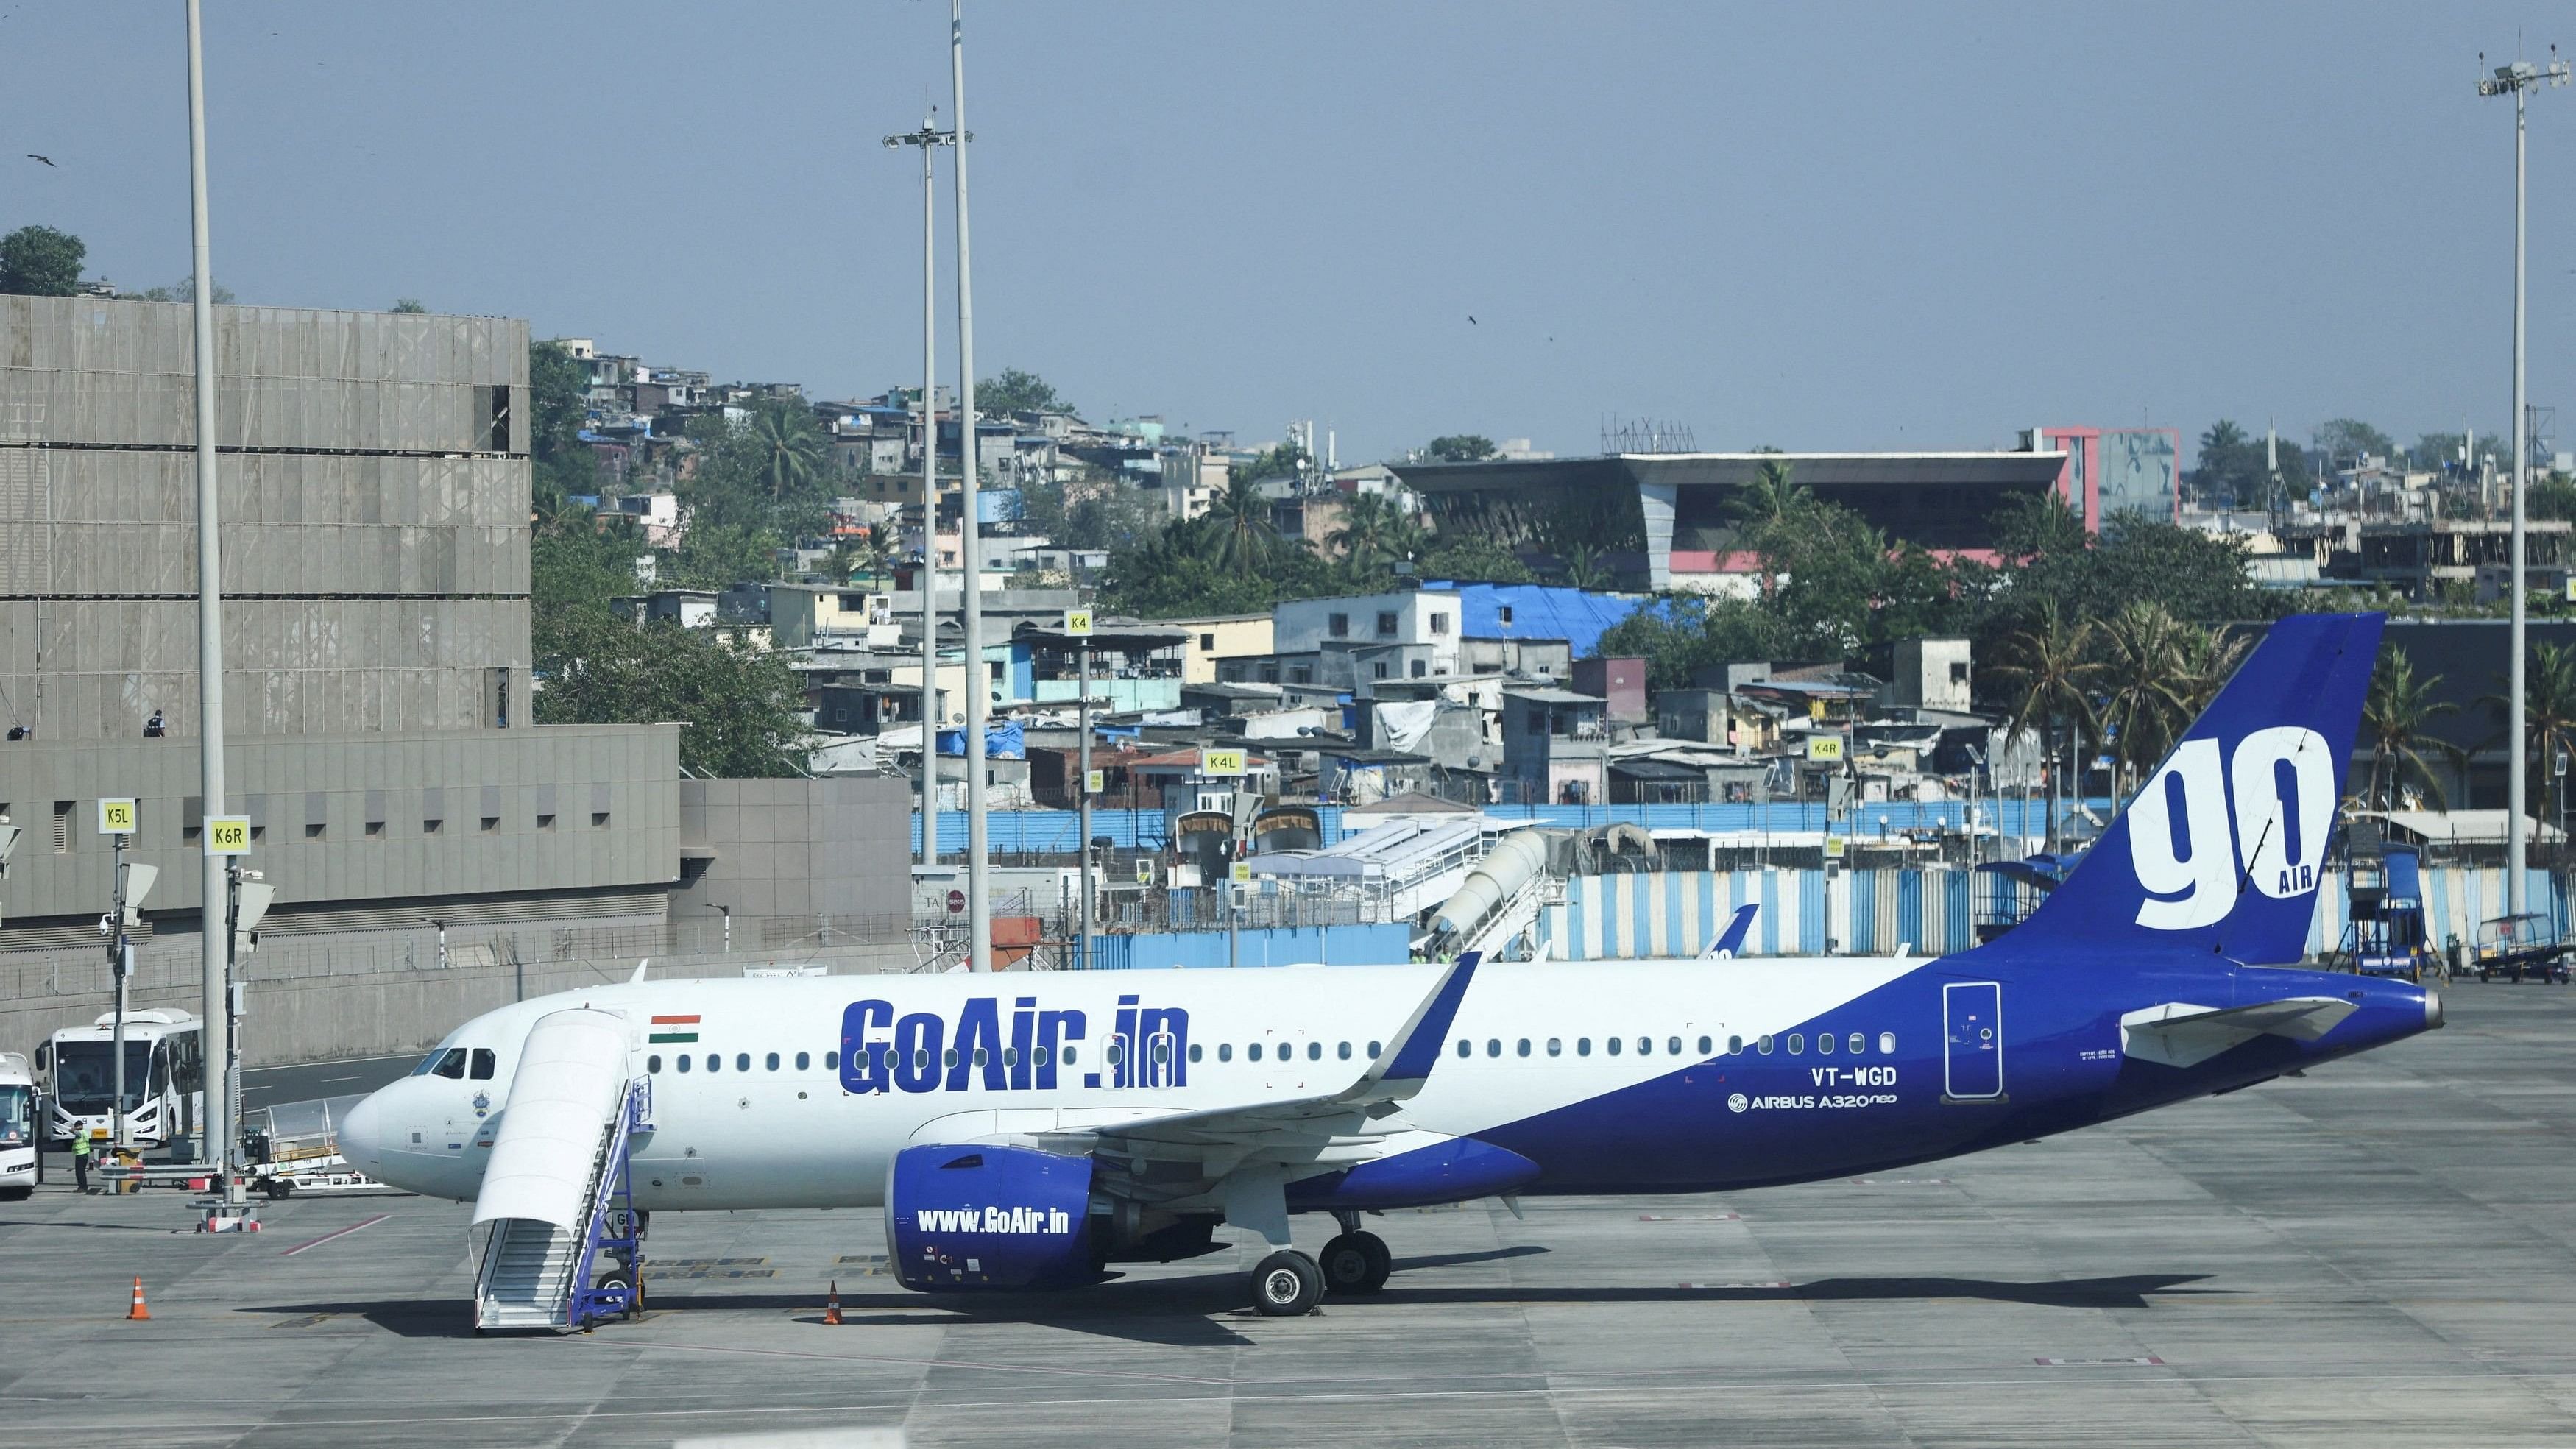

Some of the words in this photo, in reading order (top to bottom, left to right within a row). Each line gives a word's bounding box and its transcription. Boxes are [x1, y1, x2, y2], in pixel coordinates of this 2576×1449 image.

[1072, 617, 1086, 628] K4
[1815, 743, 1836, 754] K4R
[1211, 757, 1236, 768] K4L
[107, 809, 128, 823] K5L
[216, 828, 241, 843] K6R
[2127, 726, 2335, 930] go
[2279, 865, 2313, 895] AIR
[840, 995, 1189, 1094] GoAir.in
[1811, 1067, 1897, 1086] VT-WGD
[1751, 1096, 1814, 1109] AIRBUS
[918, 1206, 1069, 1233] www.GoAir.in
